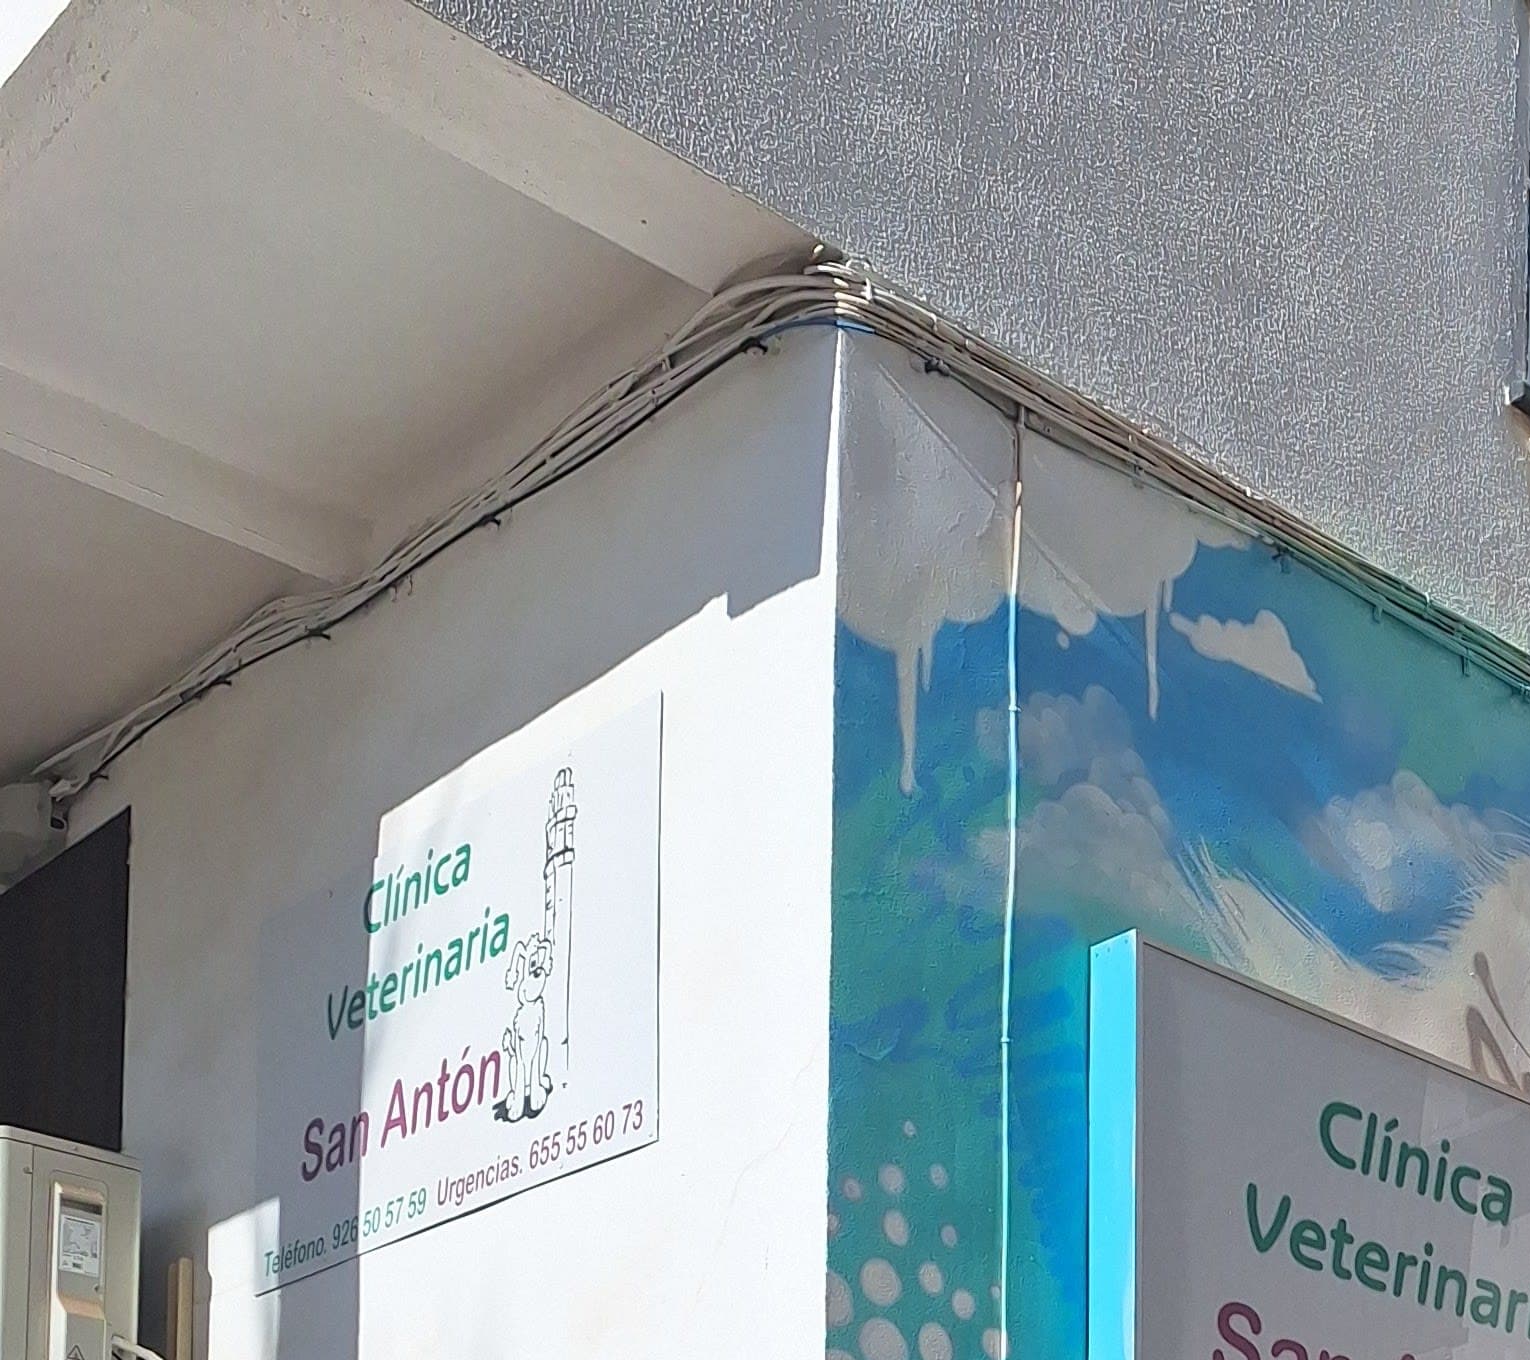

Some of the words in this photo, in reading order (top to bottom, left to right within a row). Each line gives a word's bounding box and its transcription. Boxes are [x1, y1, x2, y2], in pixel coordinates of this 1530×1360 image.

[363, 843, 472, 934] Clínica
[327, 906, 510, 1041] Veterinaria
[301, 1110, 370, 1182] San
[380, 1045, 501, 1149] Antón
[1318, 1101, 1513, 1227] Clínica
[263, 1235, 328, 1278] Teléfono.
[332, 1215, 360, 1250] 926
[362, 1209, 382, 1238] 50
[383, 1196, 404, 1230] 57
[407, 1186, 428, 1220] 59
[436, 1154, 524, 1207] Urgencias.
[528, 1130, 562, 1170] 655
[565, 1118, 589, 1157] 55
[592, 1110, 616, 1146] 60
[621, 1098, 645, 1137] 73
